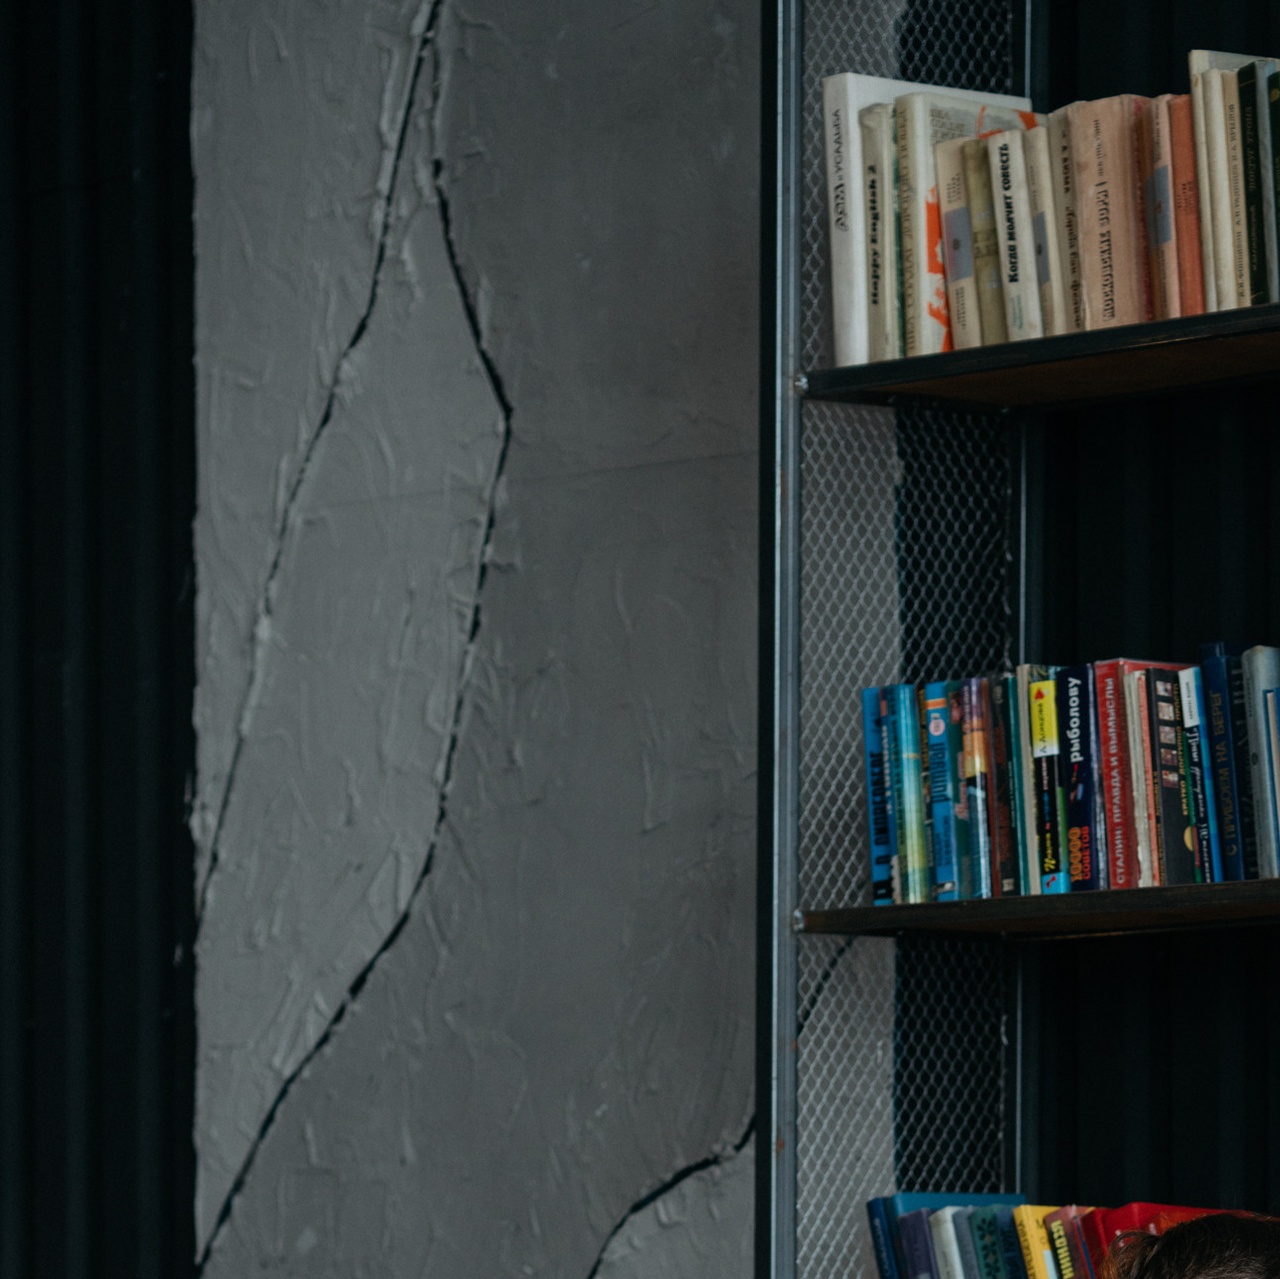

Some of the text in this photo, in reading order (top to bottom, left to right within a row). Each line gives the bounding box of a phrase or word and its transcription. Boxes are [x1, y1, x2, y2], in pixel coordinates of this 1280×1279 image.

[832, 108, 844, 174] УСАДЬБА
[998, 144, 1012, 190] совесть
[868, 165, 880, 304] Happy English 2
[1004, 195, 1016, 241] молчит
[1007, 244, 1019, 282] Когда
[1099, 231, 1115, 320] МОСКОВСКИЕ
[1067, 677, 1083, 762] рыболову
[1105, 678, 1125, 883] СТАЛИН: ПРАВДА И ВЫМЫСЛЫ
[1210, 690, 1238, 856] С ПРИБОЕМ НА БЕРЕГ
